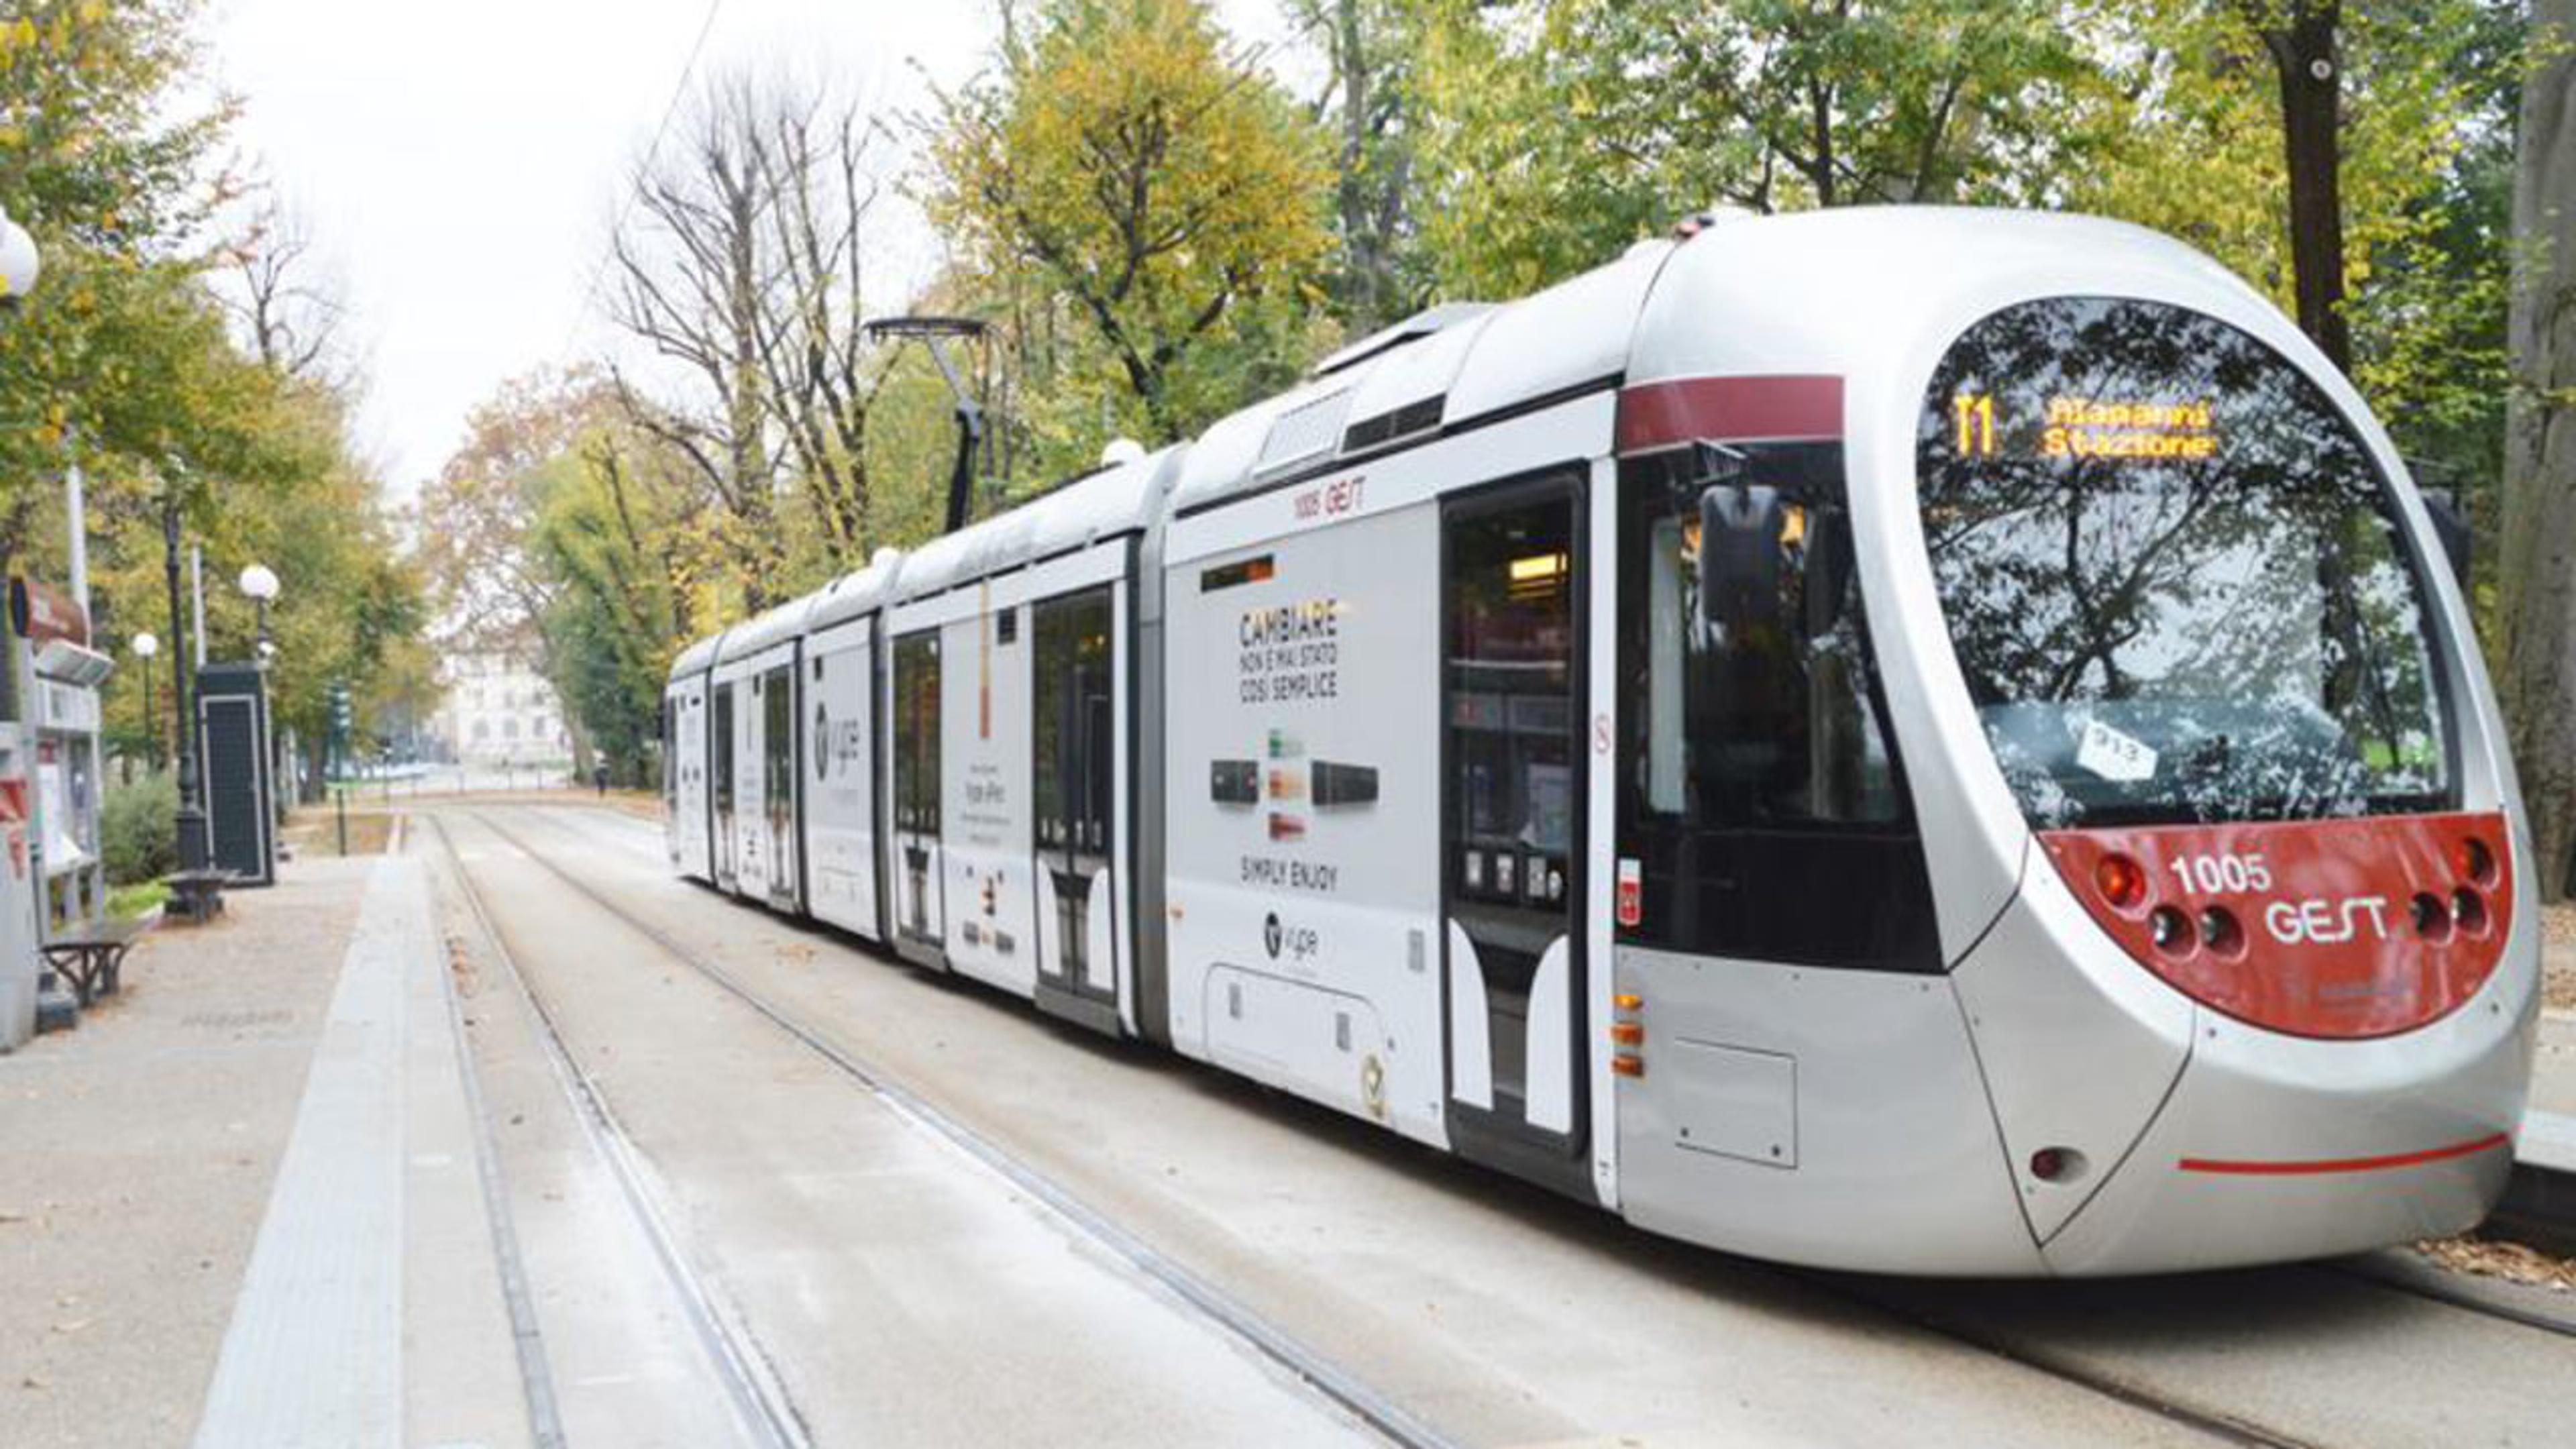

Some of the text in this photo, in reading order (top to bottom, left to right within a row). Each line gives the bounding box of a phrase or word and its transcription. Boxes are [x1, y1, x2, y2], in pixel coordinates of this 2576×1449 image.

[1953, 394, 1993, 455] T1
[2041, 427, 2216, 458] Stazione
[1326, 475, 1367, 515] GEST
[1240, 598, 1338, 648] CAMBIARE
[1240, 651, 1264, 673] NON
[1301, 641, 1338, 667] STATO
[1273, 670, 1338, 702] SEMPLICE
[1241, 853, 1338, 892] SIMPLY ENJOY
[2169, 854, 2273, 894] 1005
[2264, 895, 2387, 944] GEST
